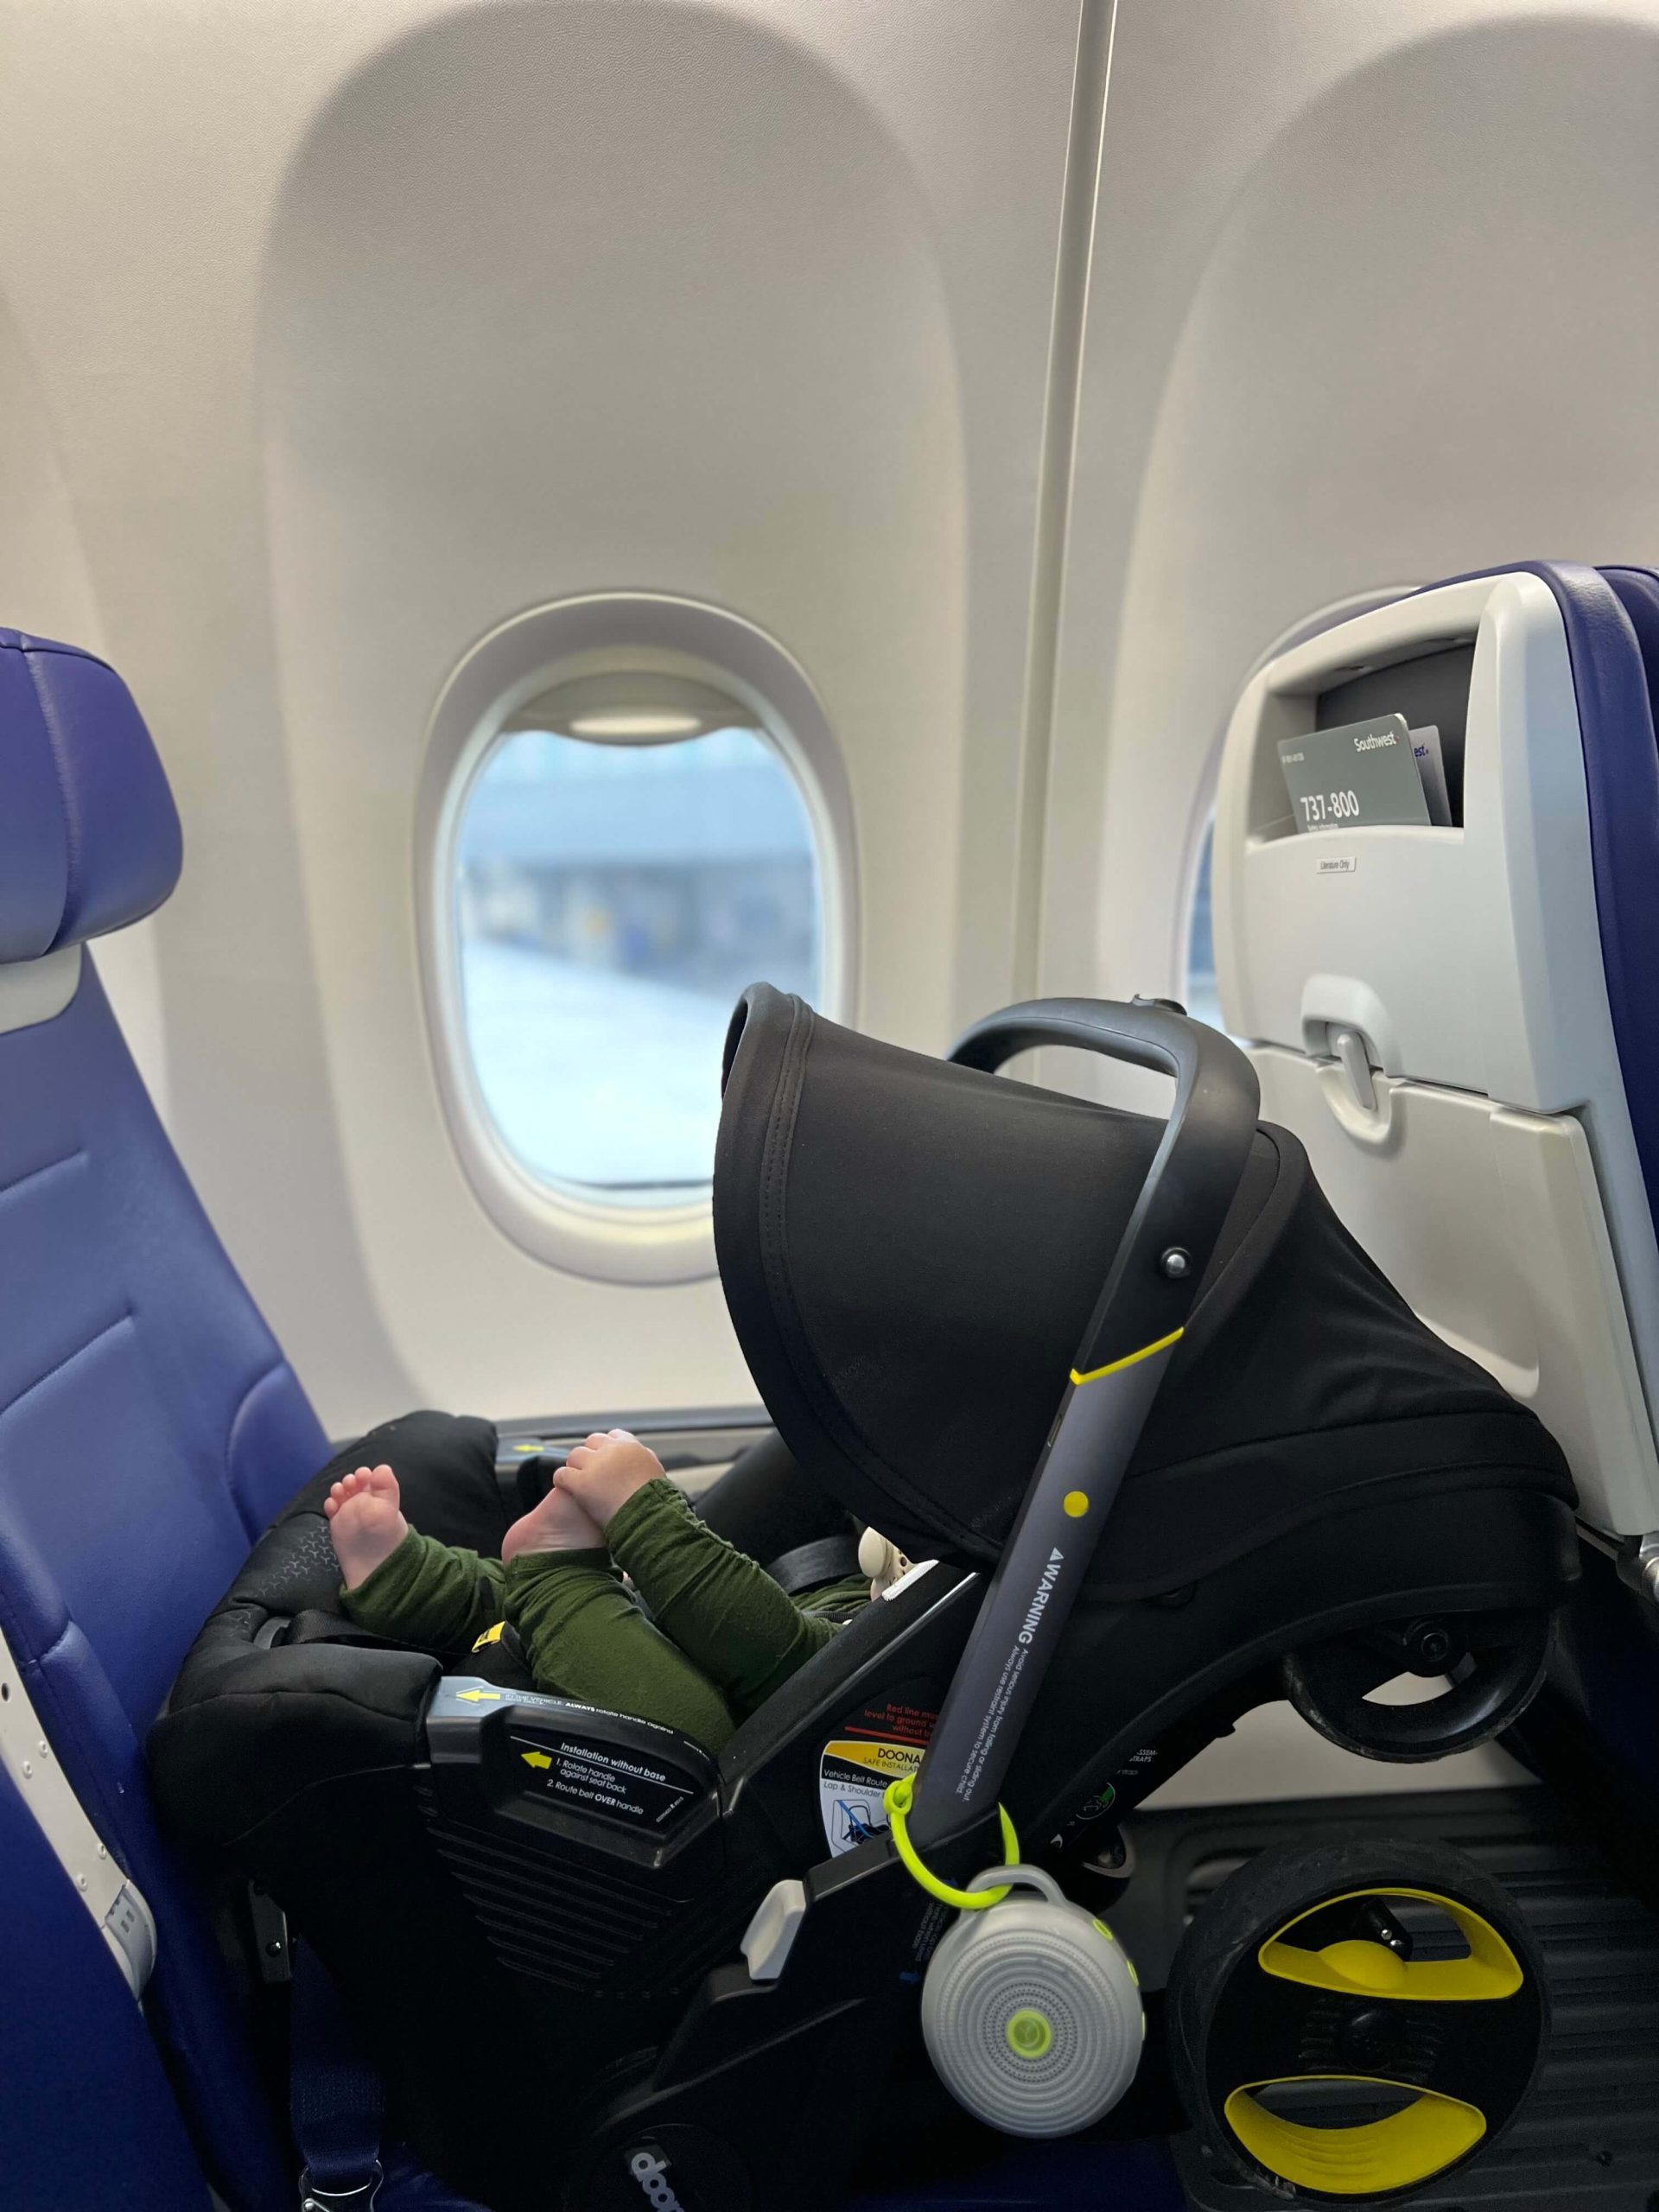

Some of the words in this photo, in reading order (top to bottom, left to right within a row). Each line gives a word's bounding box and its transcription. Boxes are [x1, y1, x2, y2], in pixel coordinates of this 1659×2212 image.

[1354, 731, 1396, 752] Southwest
[1300, 790, 1360, 822] 737-800
[1019, 1564, 1061, 1643] WARNING
[1005, 1645, 1020, 1671] Always
[1016, 1649, 1028, 1670] Avoid
[1000, 1672, 1008, 1685] use
[1006, 1671, 1020, 1694] serious
[887, 1704, 903, 1713] Red
[905, 1707, 919, 1717] line
[988, 1686, 1003, 1715] restraint
[997, 1696, 1010, 1714] injury
[565, 1702, 594, 1712] ALWAYS
[620, 1713, 645, 1724] handle
[647, 1722, 673, 1734] against
[864, 1710, 885, 1719] level
[897, 1716, 926, 1727] ground
[978, 1715, 991, 1739] system
[991, 1716, 1002, 1732] from
[893, 1725, 922, 1736] without
[561, 1743, 608, 1764] Installation
[611, 1759, 643, 1774] without
[644, 1769, 665, 1781] base
[864, 1757, 880, 1767] SAFE
[878, 1748, 920, 1764] DOONA
[964, 1750, 977, 1774] secure
[560, 1769, 588, 1781] against
[589, 1777, 606, 1787] seat
[606, 1779, 626, 1794] back
[563, 1760, 588, 1773] Rotate
[588, 1768, 615, 1782] handle
[823, 1769, 851, 1780] Vehicle
[852, 1774, 865, 1783] Belt
[867, 1777, 887, 1788] Route
[556, 1782, 577, 1794] Route
[579, 1789, 594, 1799] belt
[595, 1794, 616, 1805] OVER
[616, 1800, 643, 1815] handle
[824, 1781, 838, 1790] Lap
[848, 1785, 880, 1797] Shoulder
